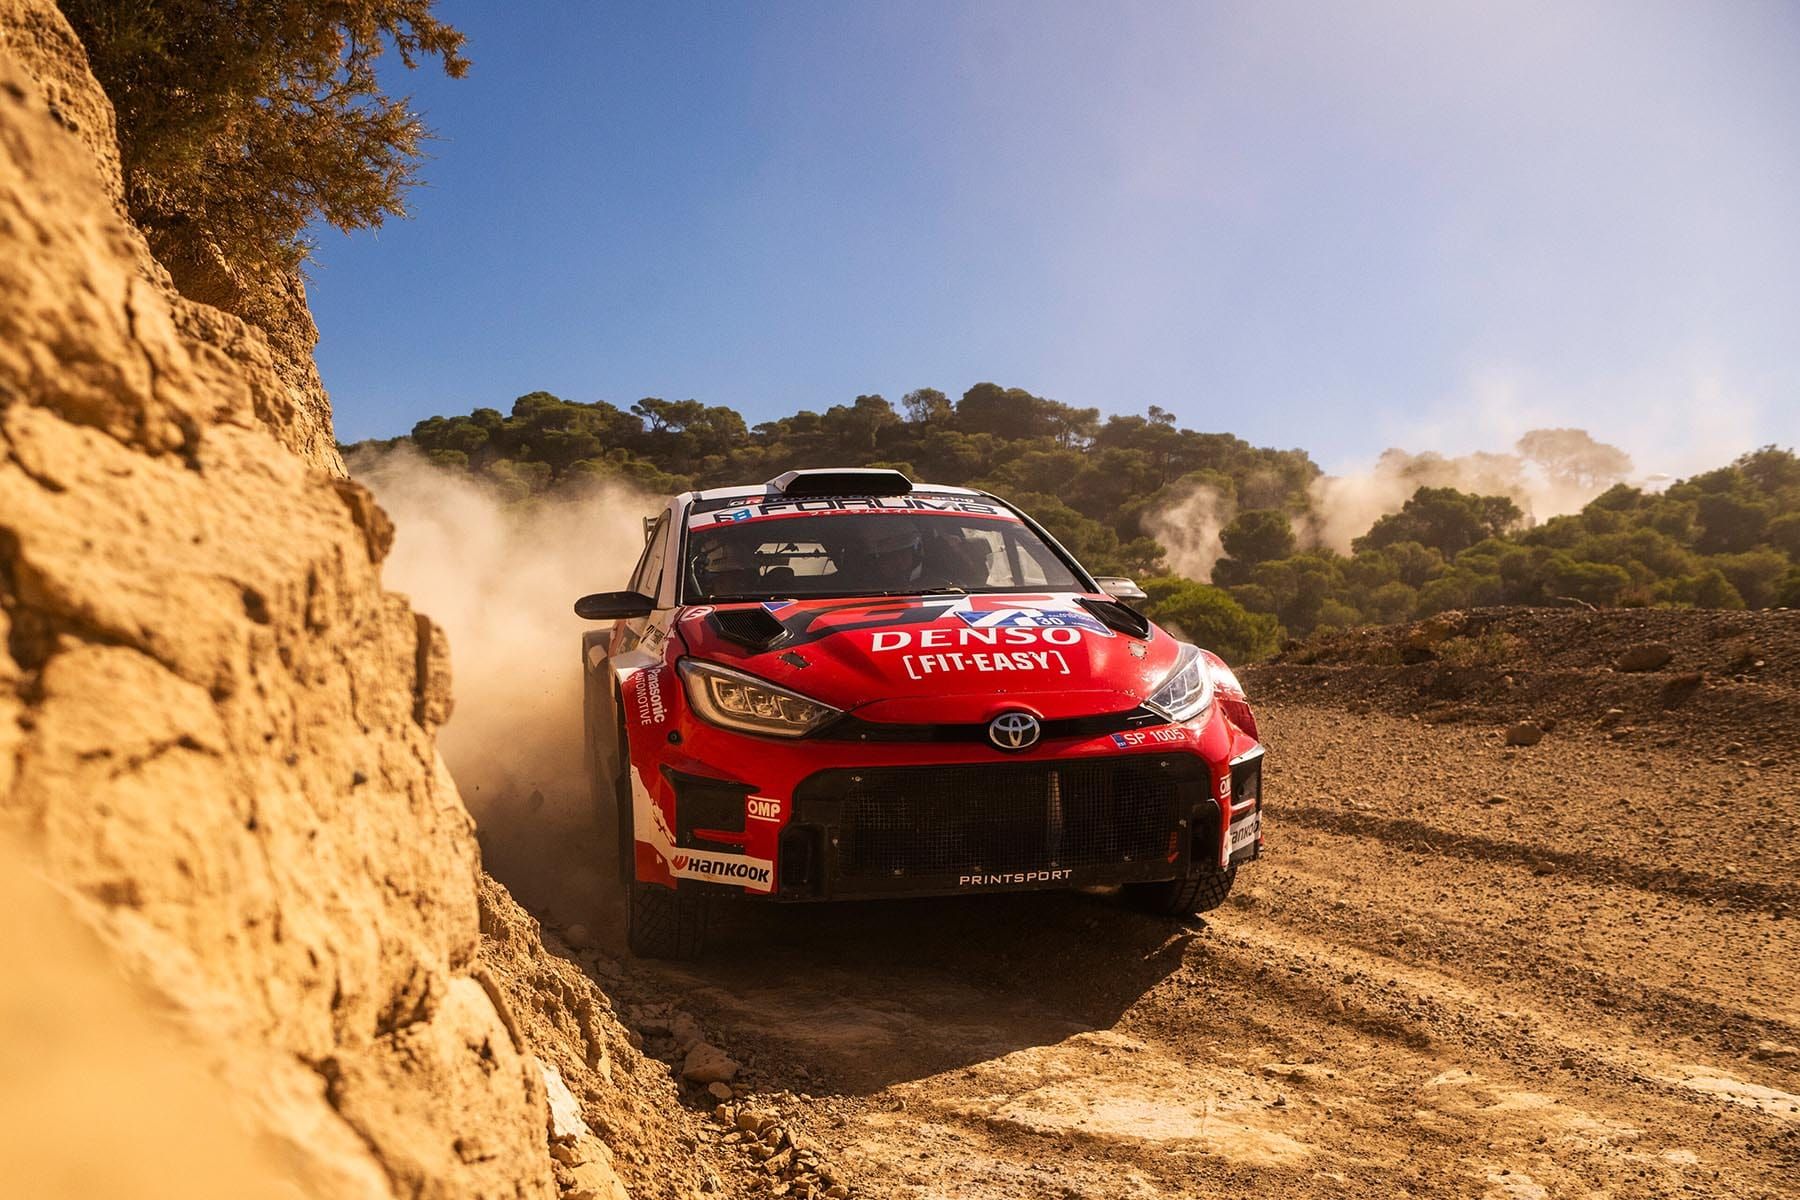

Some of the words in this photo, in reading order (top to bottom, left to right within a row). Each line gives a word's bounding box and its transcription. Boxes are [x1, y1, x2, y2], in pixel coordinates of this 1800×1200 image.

[758, 499, 998, 515] FORUM8
[1036, 616, 1066, 626] 30
[870, 627, 1082, 652] DENSO
[635, 671, 652, 726] AUTOMOTIVE
[648, 667, 667, 723] Panasonic
[1123, 732, 1146, 745] SP
[1149, 727, 1185, 743] 1005
[747, 800, 781, 818] OMP
[959, 869, 1073, 885] PRINTSPORT
